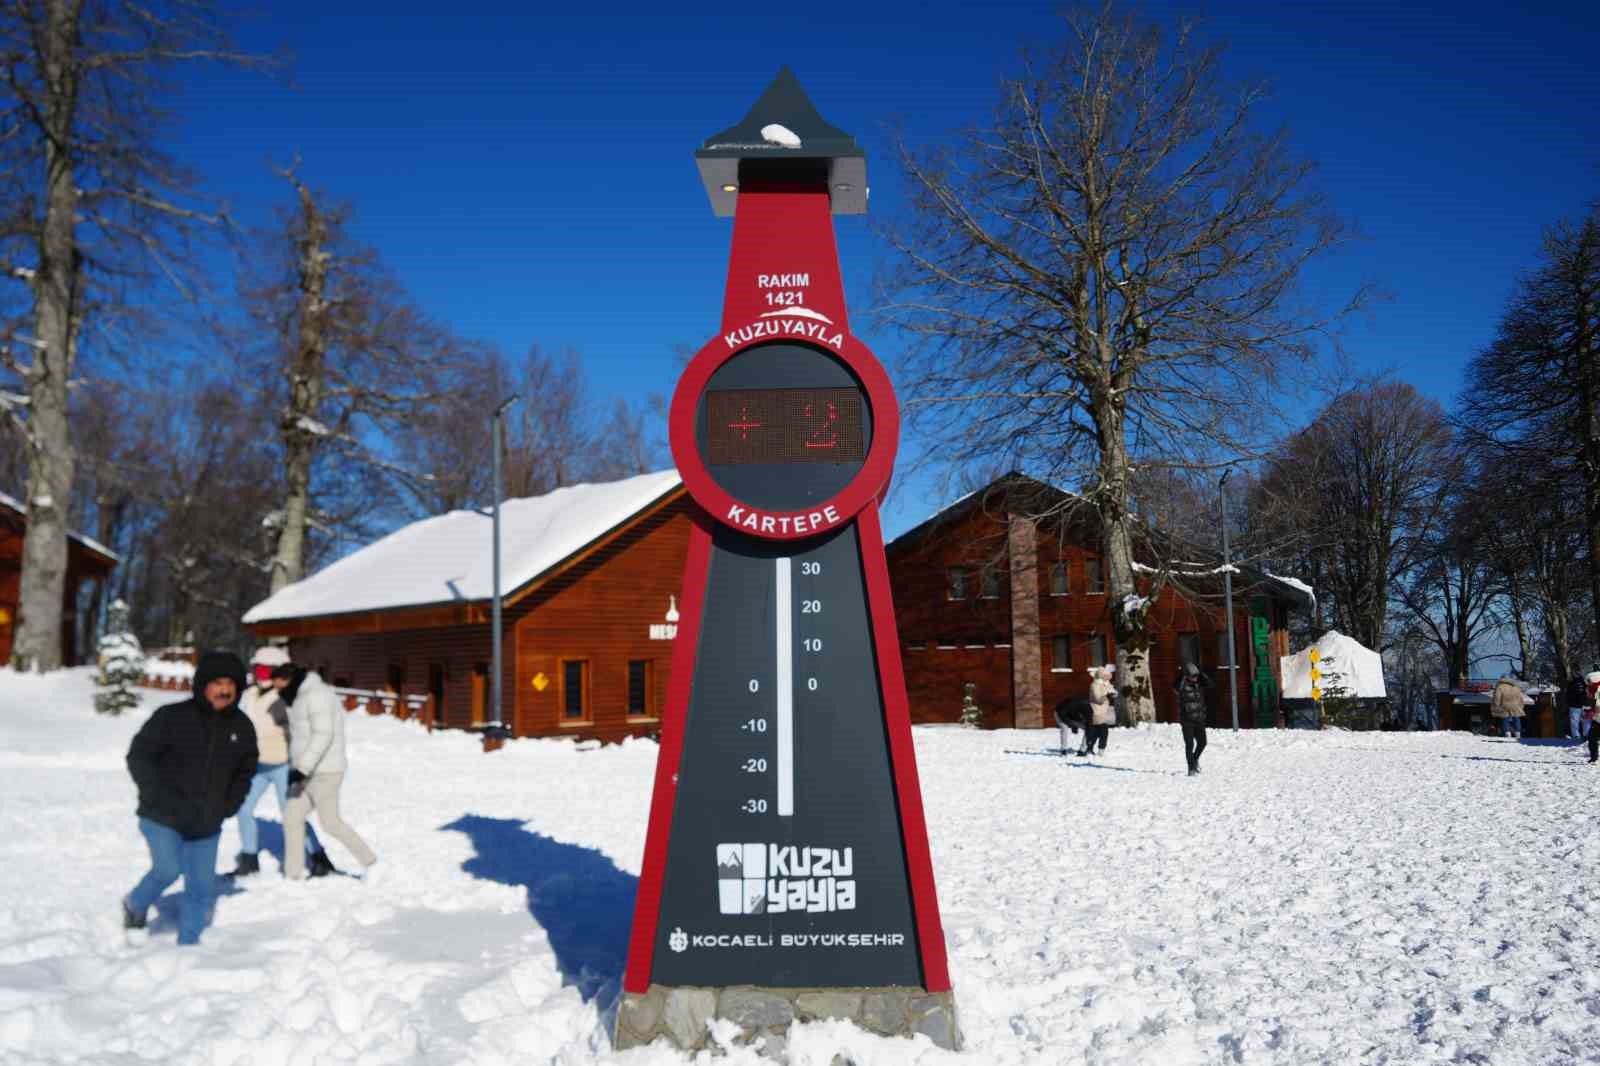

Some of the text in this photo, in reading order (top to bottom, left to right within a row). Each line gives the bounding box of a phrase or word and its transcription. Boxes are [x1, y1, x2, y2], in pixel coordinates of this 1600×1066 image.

[758, 273, 809, 288] RAKIM
[765, 291, 803, 305] 1421
[724, 320, 844, 349] KUZUYAYLA
[804, 400, 838, 448] 2
[727, 505, 840, 534] KARTEPE
[801, 561, 821, 575] 30
[801, 599, 821, 614] 20
[803, 638, 822, 652] 10
[748, 679, 759, 693] 0
[807, 677, 818, 691] 0
[741, 718, 767, 733] -10
[741, 758, 767, 773] -20
[741, 799, 768, 813] -30
[766, 877, 856, 913] yayla
